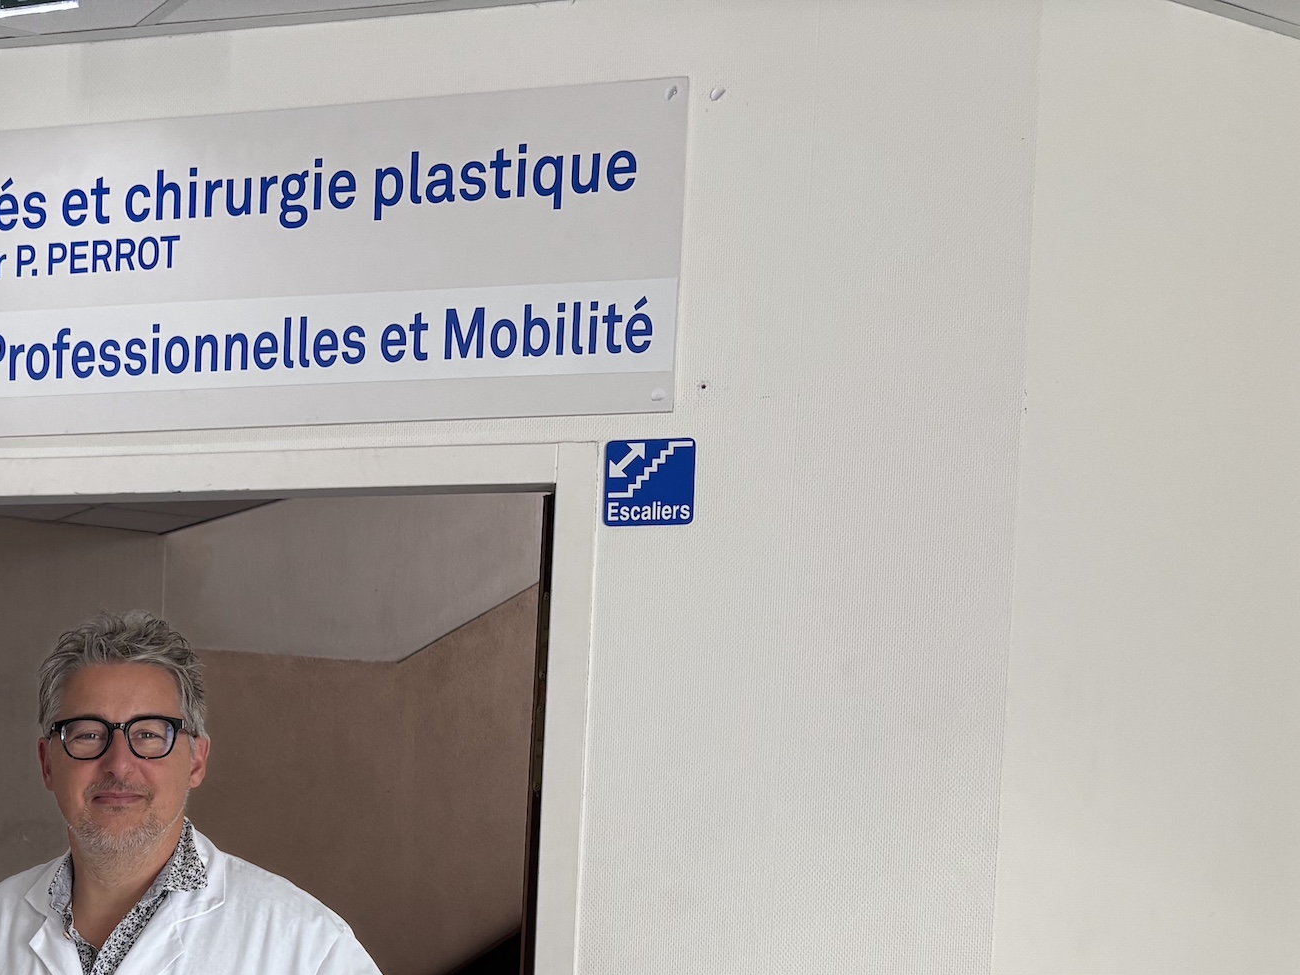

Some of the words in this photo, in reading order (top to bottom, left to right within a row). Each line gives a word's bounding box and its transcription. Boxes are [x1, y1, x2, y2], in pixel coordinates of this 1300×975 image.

[61, 177, 112, 228] et
[125, 158, 357, 230] chirurgie
[373, 143, 637, 221] plastique
[16, 244, 39, 278] P.
[47, 235, 181, 276] PERROT
[380, 313, 429, 363] et
[444, 297, 653, 361] Mobilité
[607, 501, 690, 521] Escaliers
